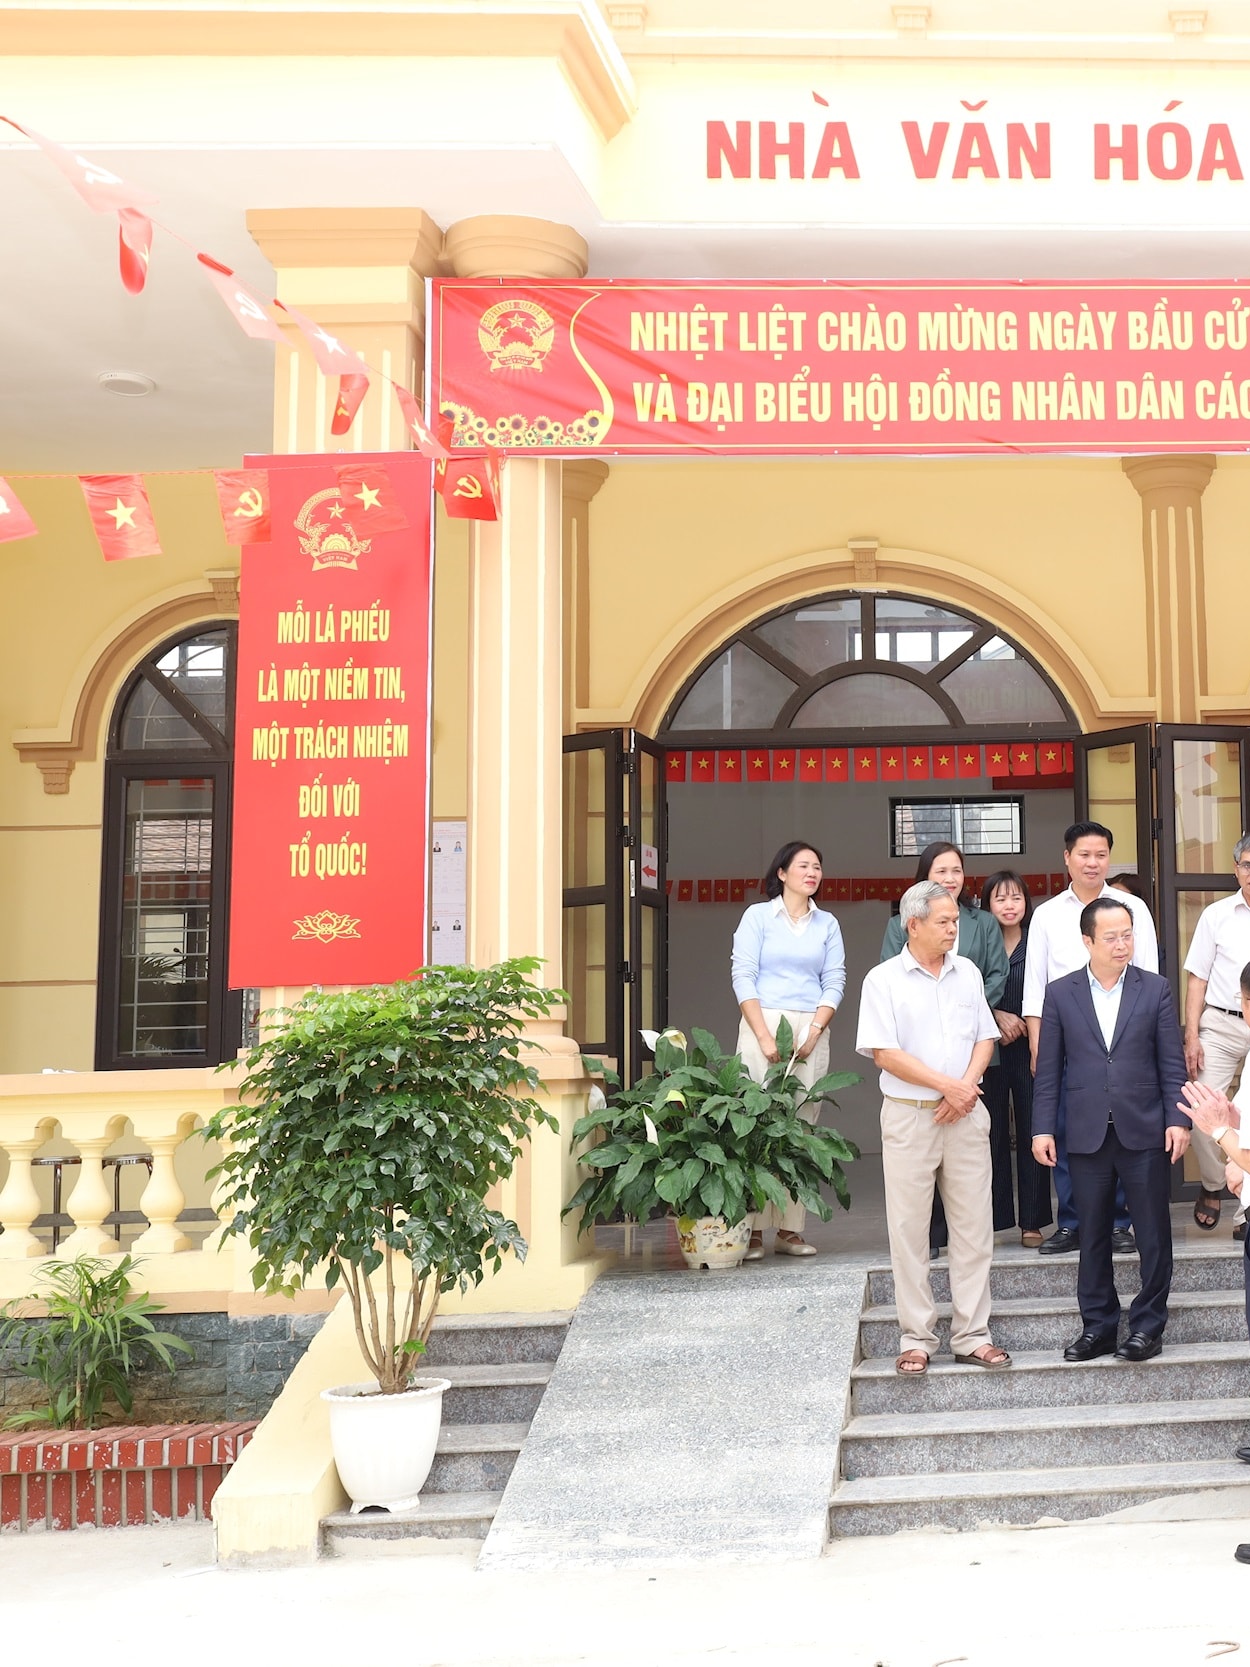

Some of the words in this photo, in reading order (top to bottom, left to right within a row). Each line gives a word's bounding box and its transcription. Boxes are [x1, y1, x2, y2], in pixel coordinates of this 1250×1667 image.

[707, 91, 860, 179] NHÀ
[902, 100, 1051, 179] VĂN
[1094, 100, 1244, 181] HÓA
[631, 304, 728, 360] NHIỆT
[739, 304, 806, 360] LIỆT
[818, 304, 906, 351] CHÀO
[918, 303, 1017, 351] MỪNG
[1029, 303, 1117, 351] NGÀY
[1128, 297, 1193, 350] BẦU
[1204, 298, 1250, 350] CỬ
[633, 374, 676, 422] VÀ
[687, 382, 743, 431] ĐẠI
[757, 366, 831, 422] BIỂU
[843, 374, 898, 430] HỘI
[909, 368, 1001, 421] ĐỒNG
[1012, 373, 1105, 420] NHÂN
[1116, 372, 1184, 420] DÂN
[278, 600, 310, 643] MỖI
[315, 604, 335, 642] LÁ
[340, 599, 390, 642] PHIẾU
[258, 663, 278, 702] LÀ
[284, 662, 320, 708] MỘT
[325, 657, 368, 700] NIỀM
[374, 667, 405, 703] TIN,
[253, 721, 289, 767] MỘT
[294, 720, 348, 759] TRÁCH
[353, 718, 408, 764] NHIỆM
[299, 773, 327, 817] ĐỐI
[333, 777, 360, 817] VỚI
[290, 831, 311, 877] TỔ
[315, 831, 366, 880] QUỐC!
